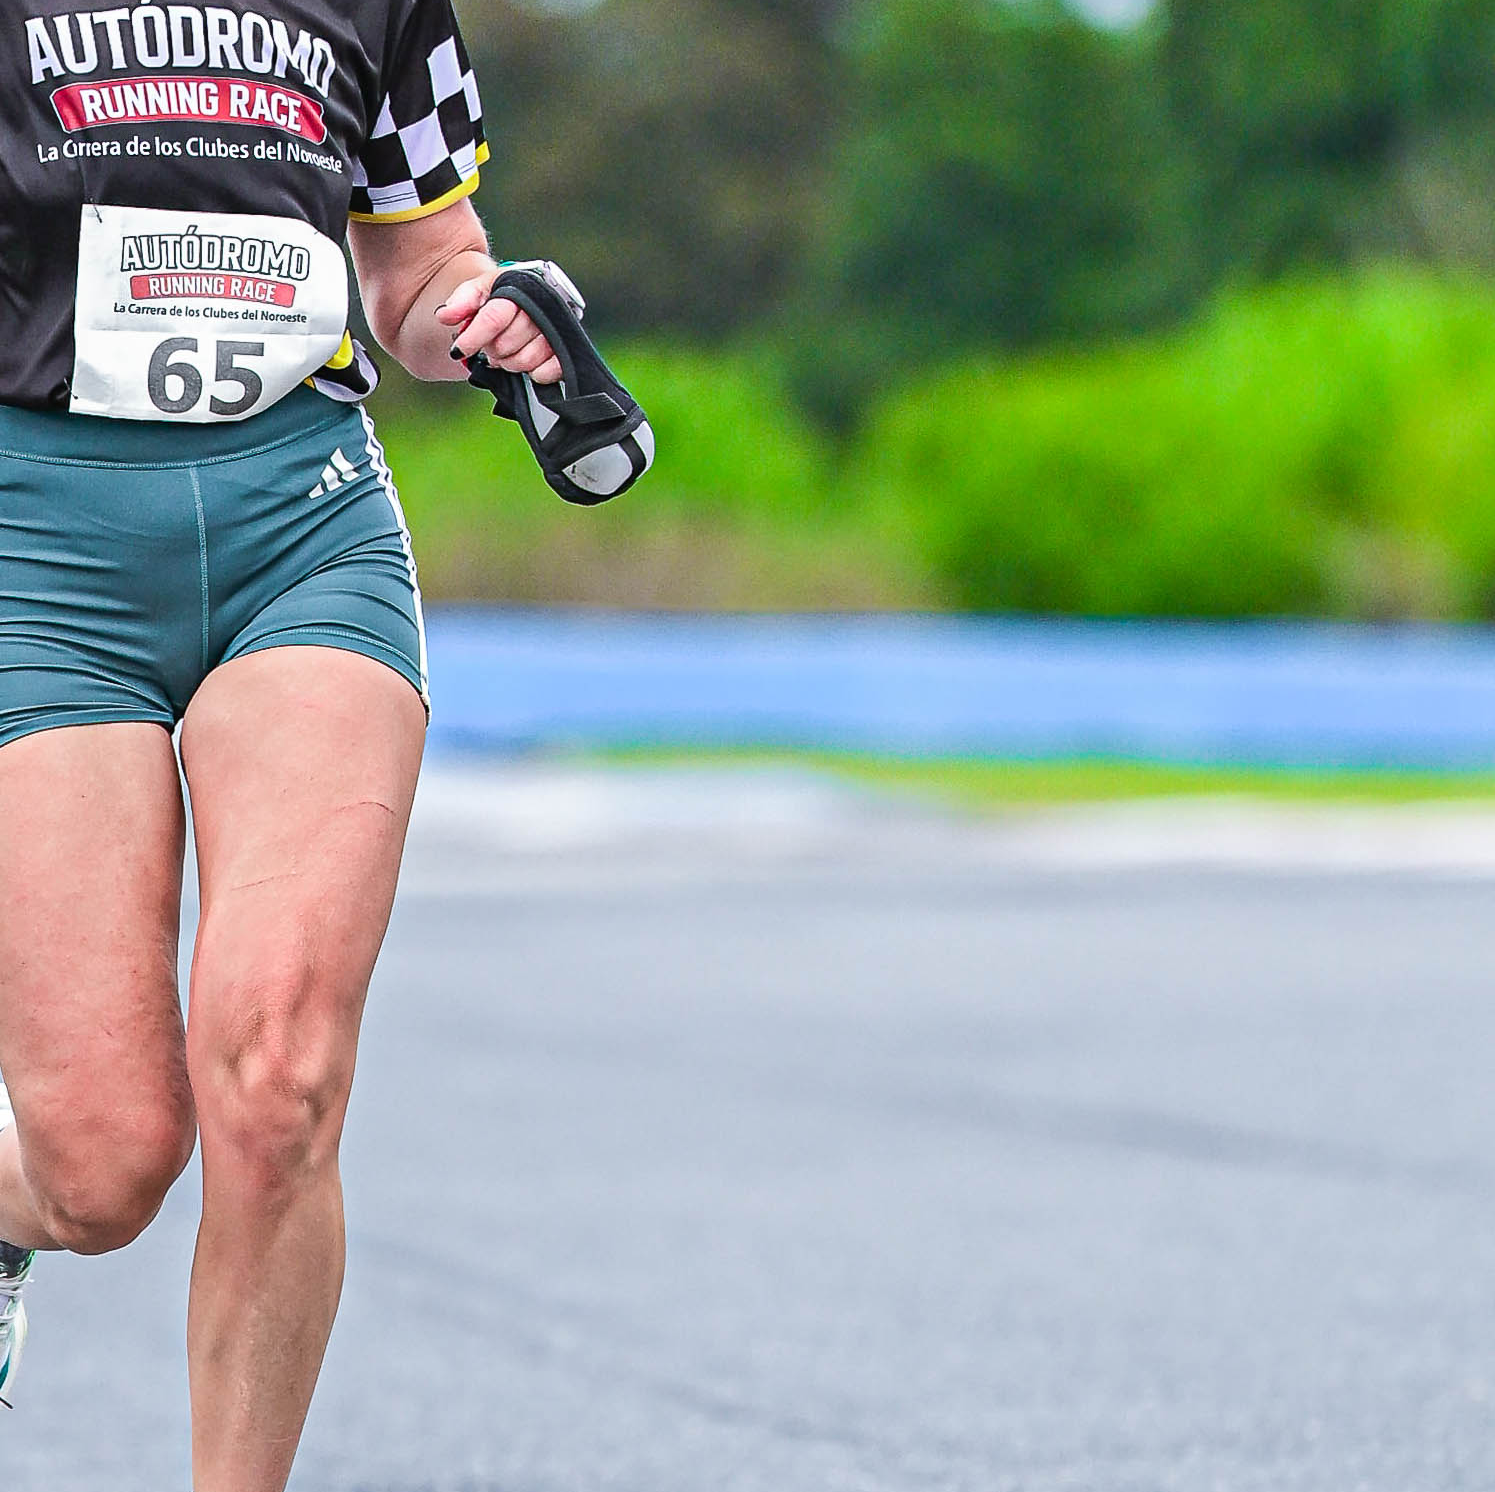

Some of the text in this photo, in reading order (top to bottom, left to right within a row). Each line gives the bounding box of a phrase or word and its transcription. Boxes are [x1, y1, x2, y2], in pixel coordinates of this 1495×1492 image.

[79, 82, 303, 132] RUNNING RACE
[37, 144, 59, 163] La
[63, 139, 121, 158] Crrera
[126, 136, 151, 156] de
[155, 136, 182, 157] los
[186, 137, 249, 159] Clubes
[254, 140, 282, 161] del
[120, 224, 310, 281] AUTÓDROMO
[149, 276, 277, 303] RUNNING RACE
[114, 302, 307, 323] La Carrera de los Clubes del Noroeste
[147, 337, 265, 416] 65
